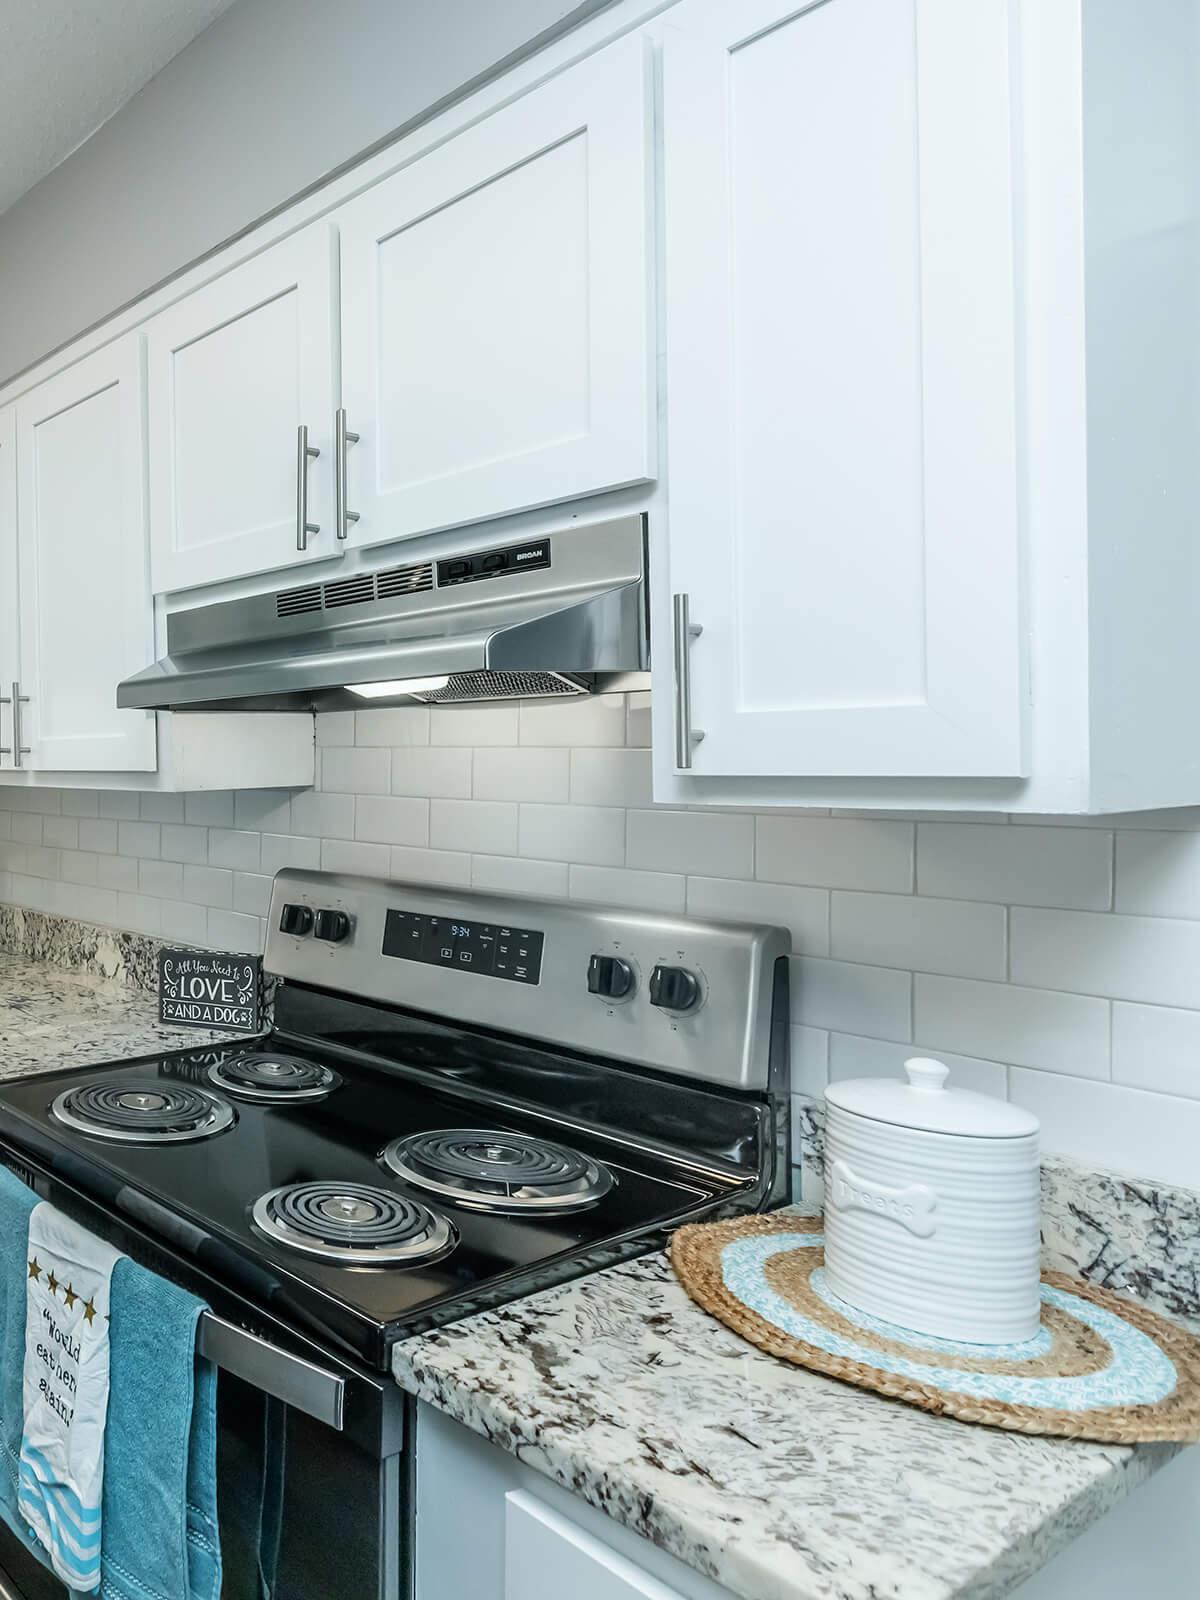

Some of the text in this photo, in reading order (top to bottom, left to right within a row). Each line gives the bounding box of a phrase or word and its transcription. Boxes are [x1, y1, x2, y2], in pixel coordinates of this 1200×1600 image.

[516, 549, 543, 561] BROAN
[450, 924, 471, 937] 9:34
[176, 960, 241, 980] All You Need Is
[180, 976, 235, 1002] LOVE
[174, 1003, 241, 1024] AND A DOG
[839, 1178, 914, 1217] Treats
[36, 1343, 56, 1371] eat
